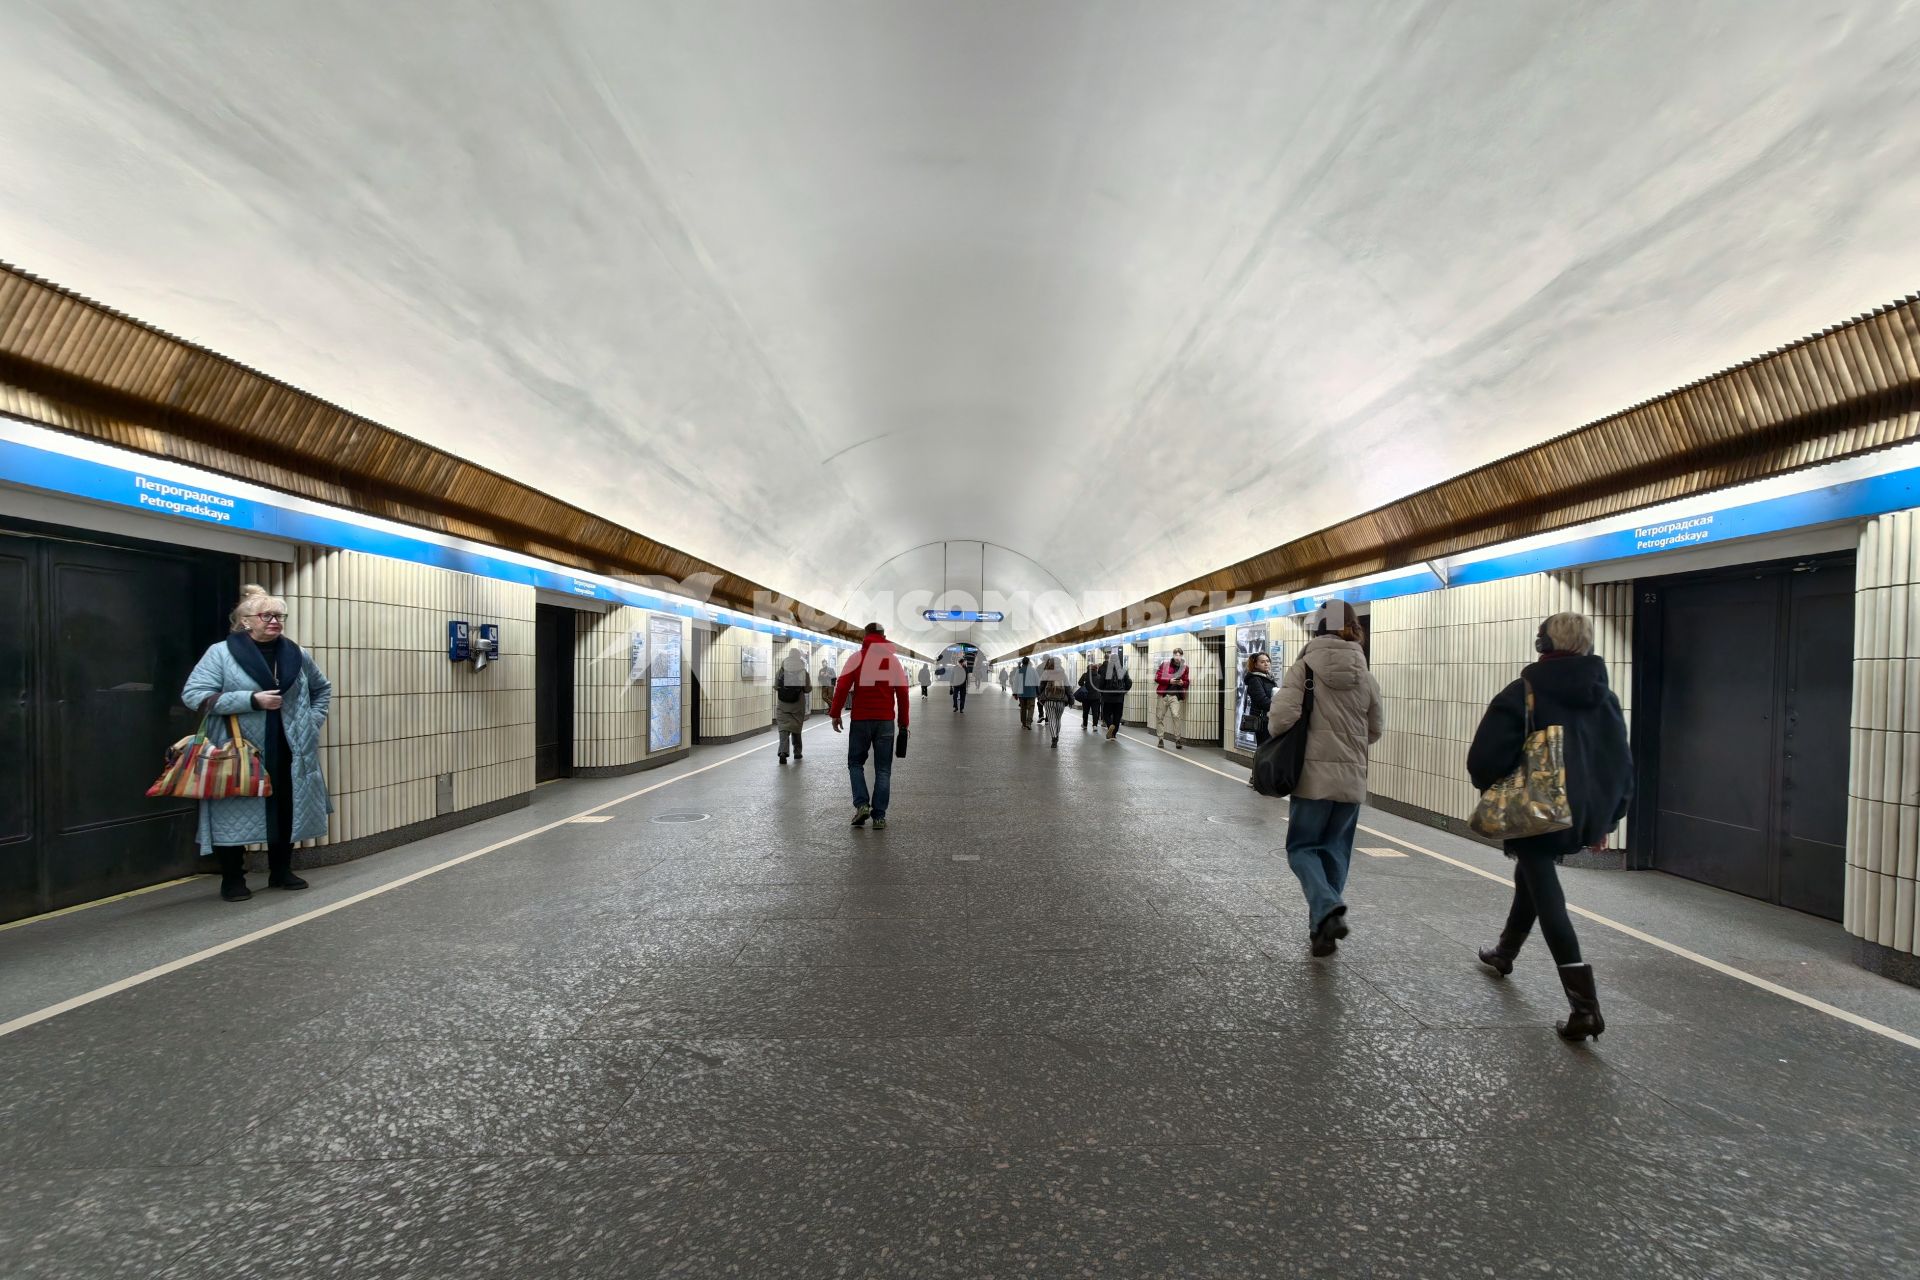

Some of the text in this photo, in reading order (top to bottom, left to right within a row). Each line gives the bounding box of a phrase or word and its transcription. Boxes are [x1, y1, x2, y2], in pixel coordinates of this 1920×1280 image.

[135, 476, 235, 508] Петроградская
[140, 493, 230, 521] Petrogradskaya
[1634, 515, 1714, 539] Петроградская
[1636, 530, 1709, 550] Petrogradskaya
